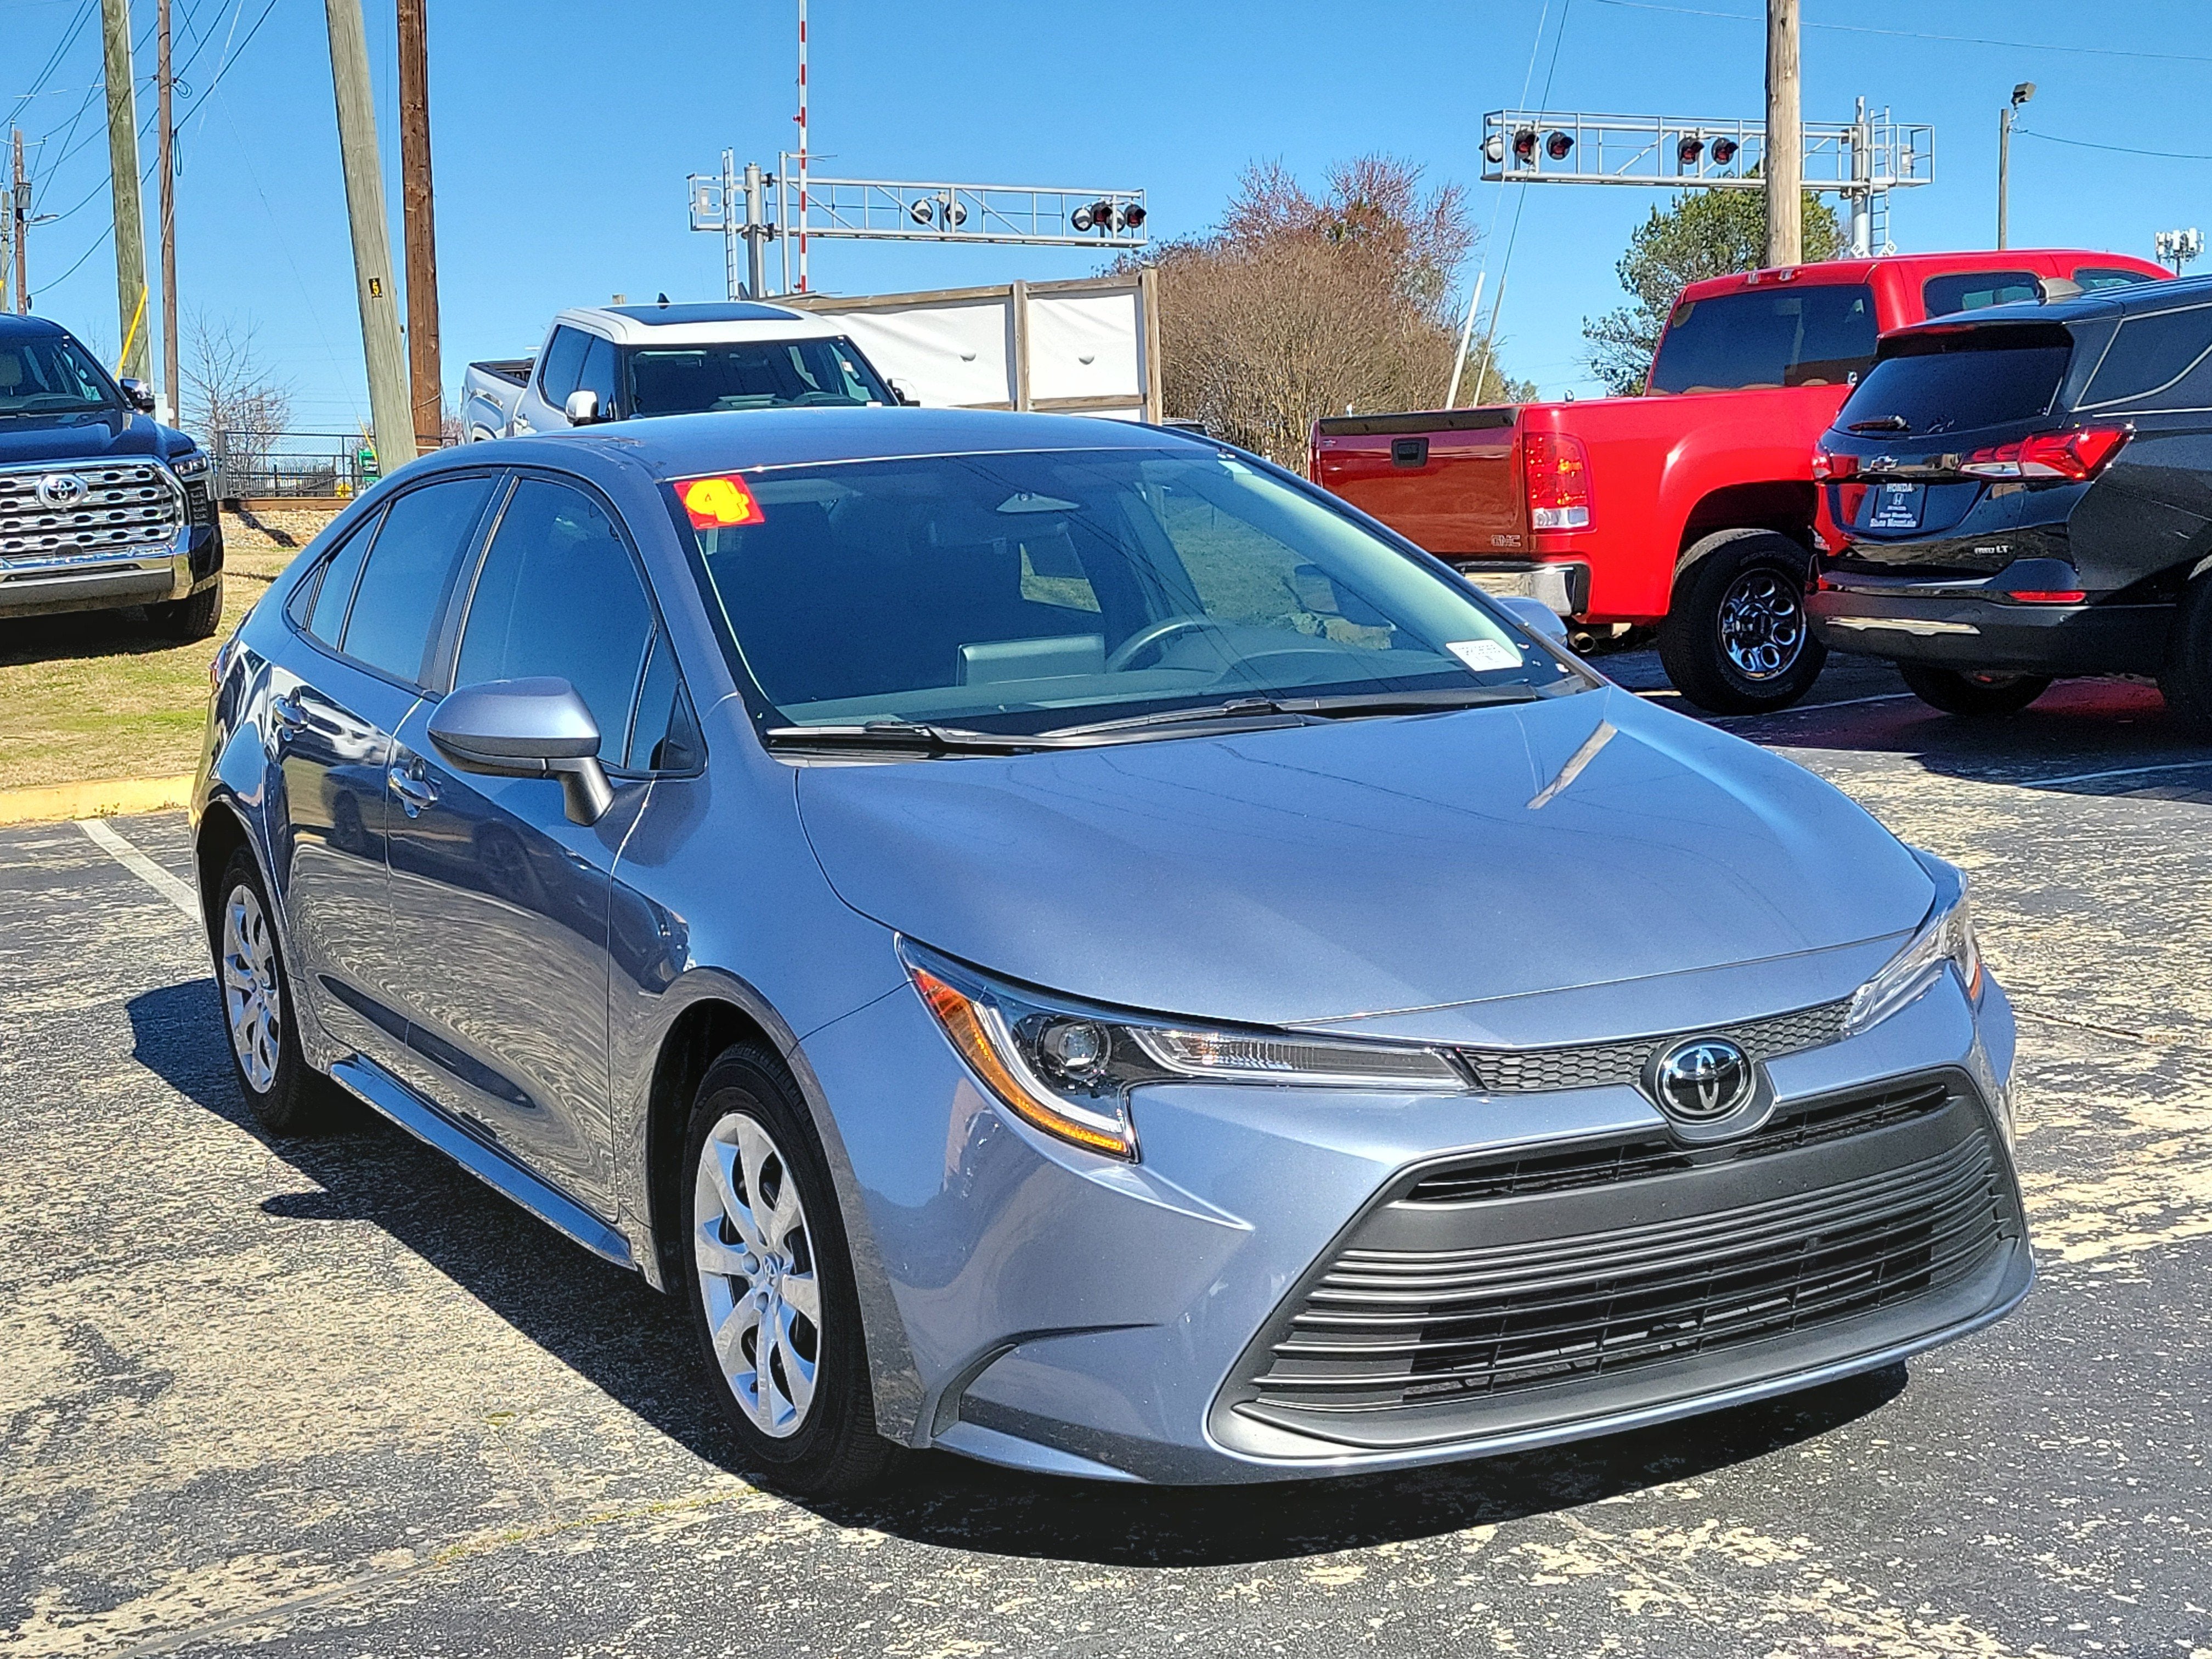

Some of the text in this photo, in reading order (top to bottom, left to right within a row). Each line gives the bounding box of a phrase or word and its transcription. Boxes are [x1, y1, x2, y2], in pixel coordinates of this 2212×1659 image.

[1886, 483, 1913, 493] HONDA
[1491, 534, 1521, 547] GMC
[1996, 545, 2008, 554] LT
